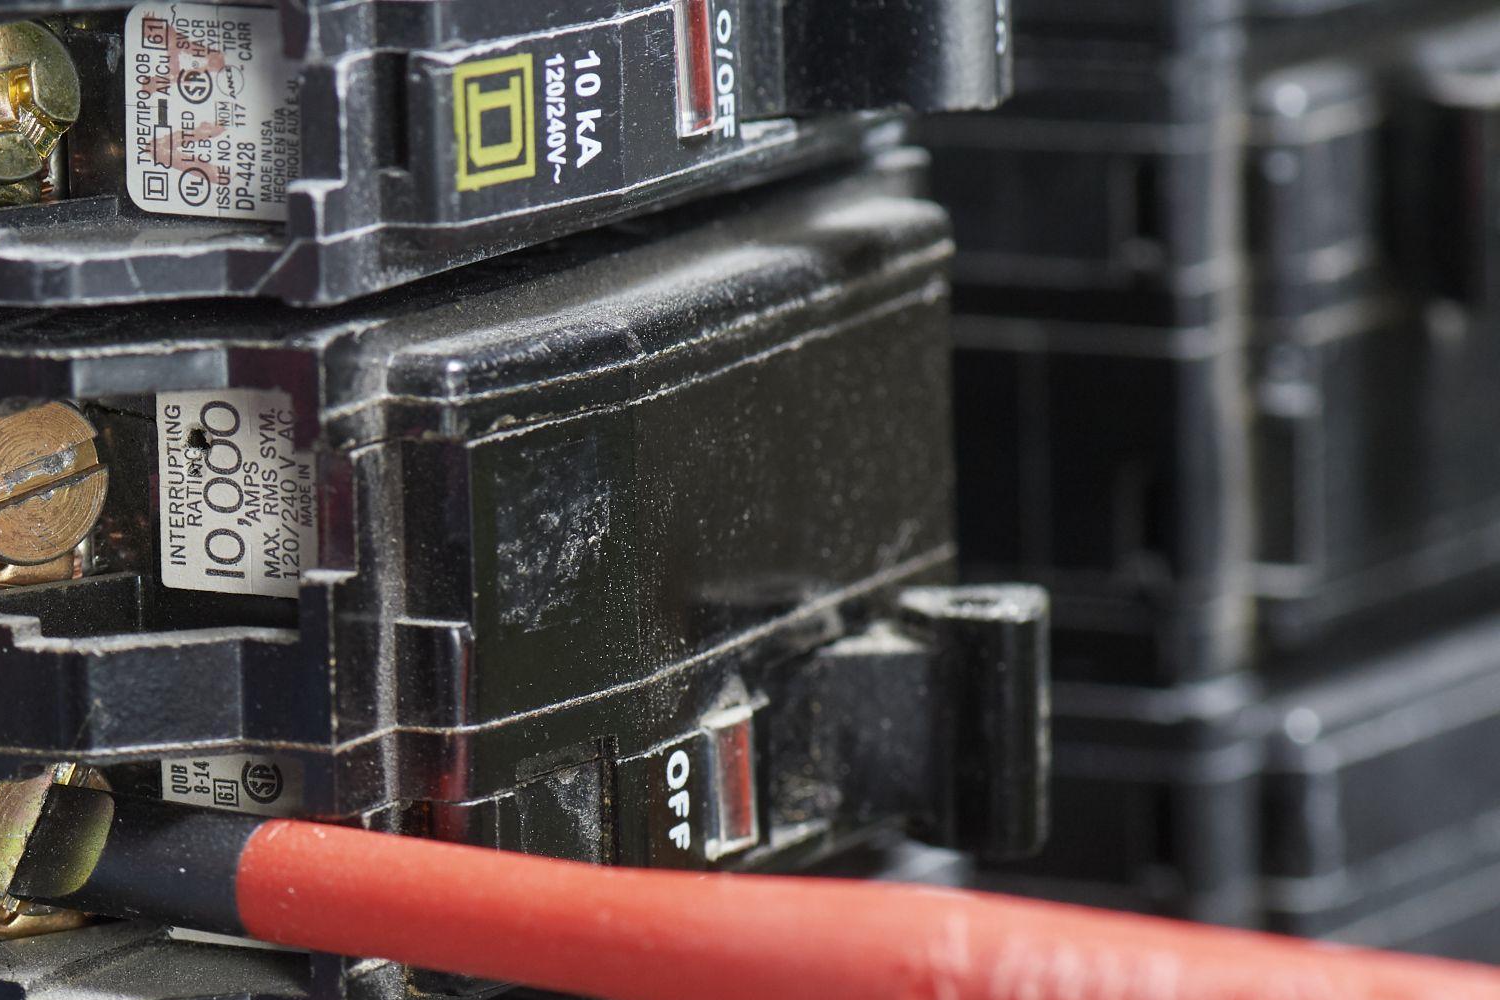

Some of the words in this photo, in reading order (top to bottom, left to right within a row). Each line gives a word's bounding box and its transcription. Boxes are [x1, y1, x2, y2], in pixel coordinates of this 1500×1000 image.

[148, 25, 163, 44] 61
[177, 19, 189, 49] SWD
[192, 20, 205, 57] HACR
[207, 21, 220, 53] TYPE
[223, 21, 236, 52] TIPO
[137, 54, 150, 85] QOB
[225, 65, 236, 98] ANCE
[574, 50, 601, 96] 10
[137, 91, 151, 164] TYPE/TIPO
[218, 102, 230, 126] NOM
[235, 104, 246, 127] 117
[274, 108, 285, 132] EUA
[288, 110, 299, 136] AUX
[182, 111, 195, 162] LISTED
[199, 136, 211, 163] C.B.
[218, 135, 230, 161] NO.
[261, 120, 272, 145] USA
[274, 137, 285, 154] EN
[576, 109, 601, 168] kA
[261, 149, 272, 161] IN
[288, 140, 299, 178] RIQUE
[217, 165, 231, 209] ISSUE
[237, 142, 255, 210] DP-4428
[261, 166, 273, 202] MADE
[274, 158, 285, 203] HECHO
[260, 408, 276, 458] SYM.
[165, 405, 186, 565] INTERRUPTING
[200, 401, 252, 579] 10,000
[299, 465, 309, 479] IN
[244, 461, 261, 522] AMPS
[262, 470, 279, 516] RMS
[299, 486, 313, 527] MADE
[281, 480, 299, 579] 120/240
[264, 528, 280, 578] MAX.
[194, 761, 210, 794] 8-14
[218, 784, 234, 800] 61
[667, 750, 690, 850] OFF
